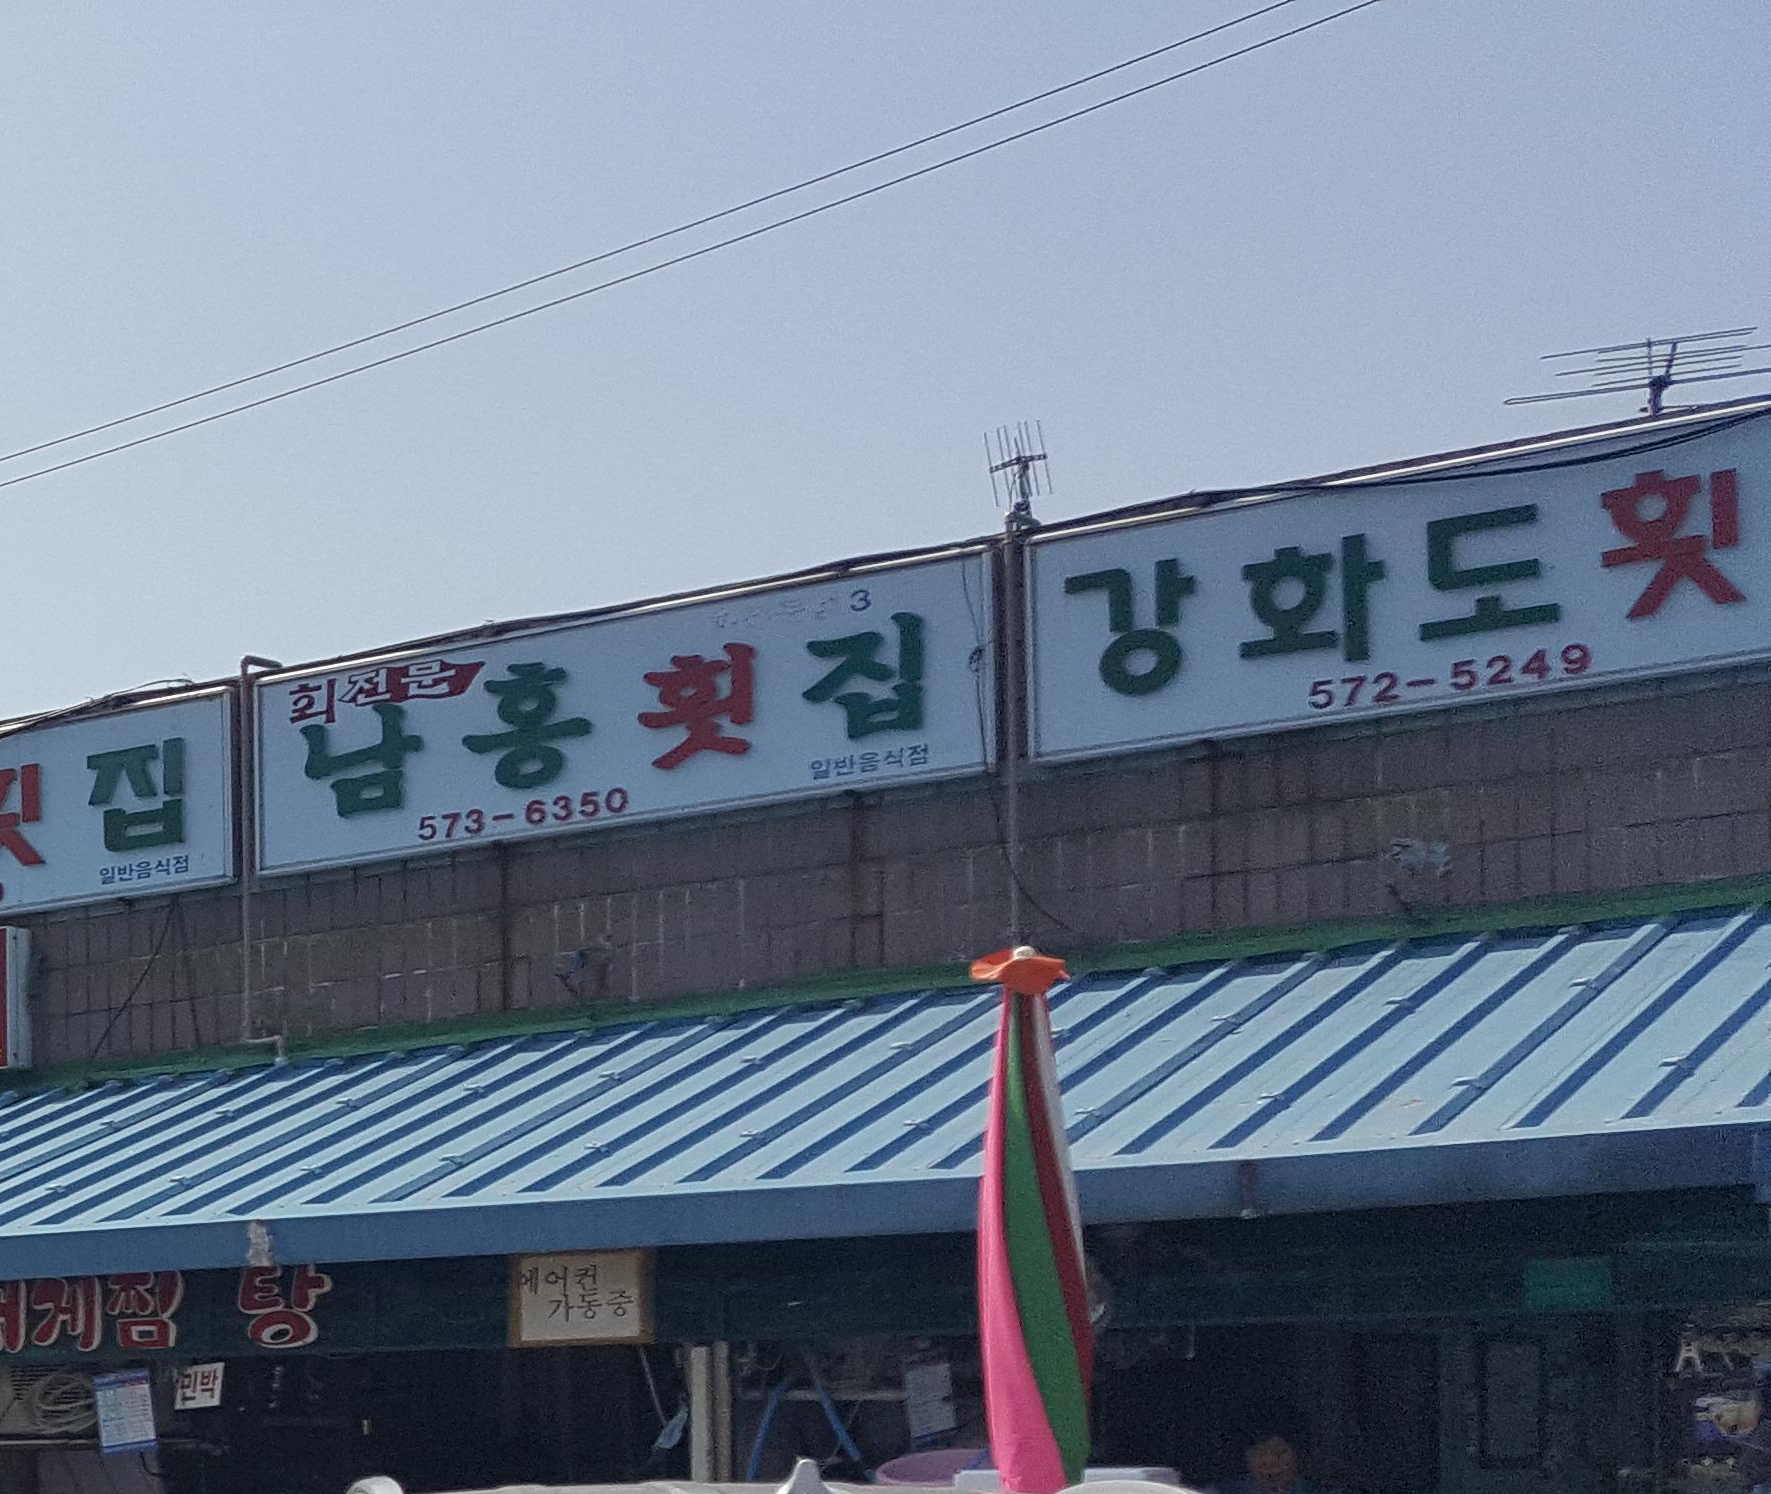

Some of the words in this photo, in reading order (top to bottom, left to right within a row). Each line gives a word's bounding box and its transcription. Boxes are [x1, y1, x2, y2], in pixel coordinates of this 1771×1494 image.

[849, 589, 872, 612] 3
[1308, 642, 1594, 711] 572-5249
[809, 743, 930, 781] 일반음식점
[418, 787, 630, 841] 573-6350
[98, 854, 190, 885] 일반음식점
[237, 1263, 334, 1349] 탕
